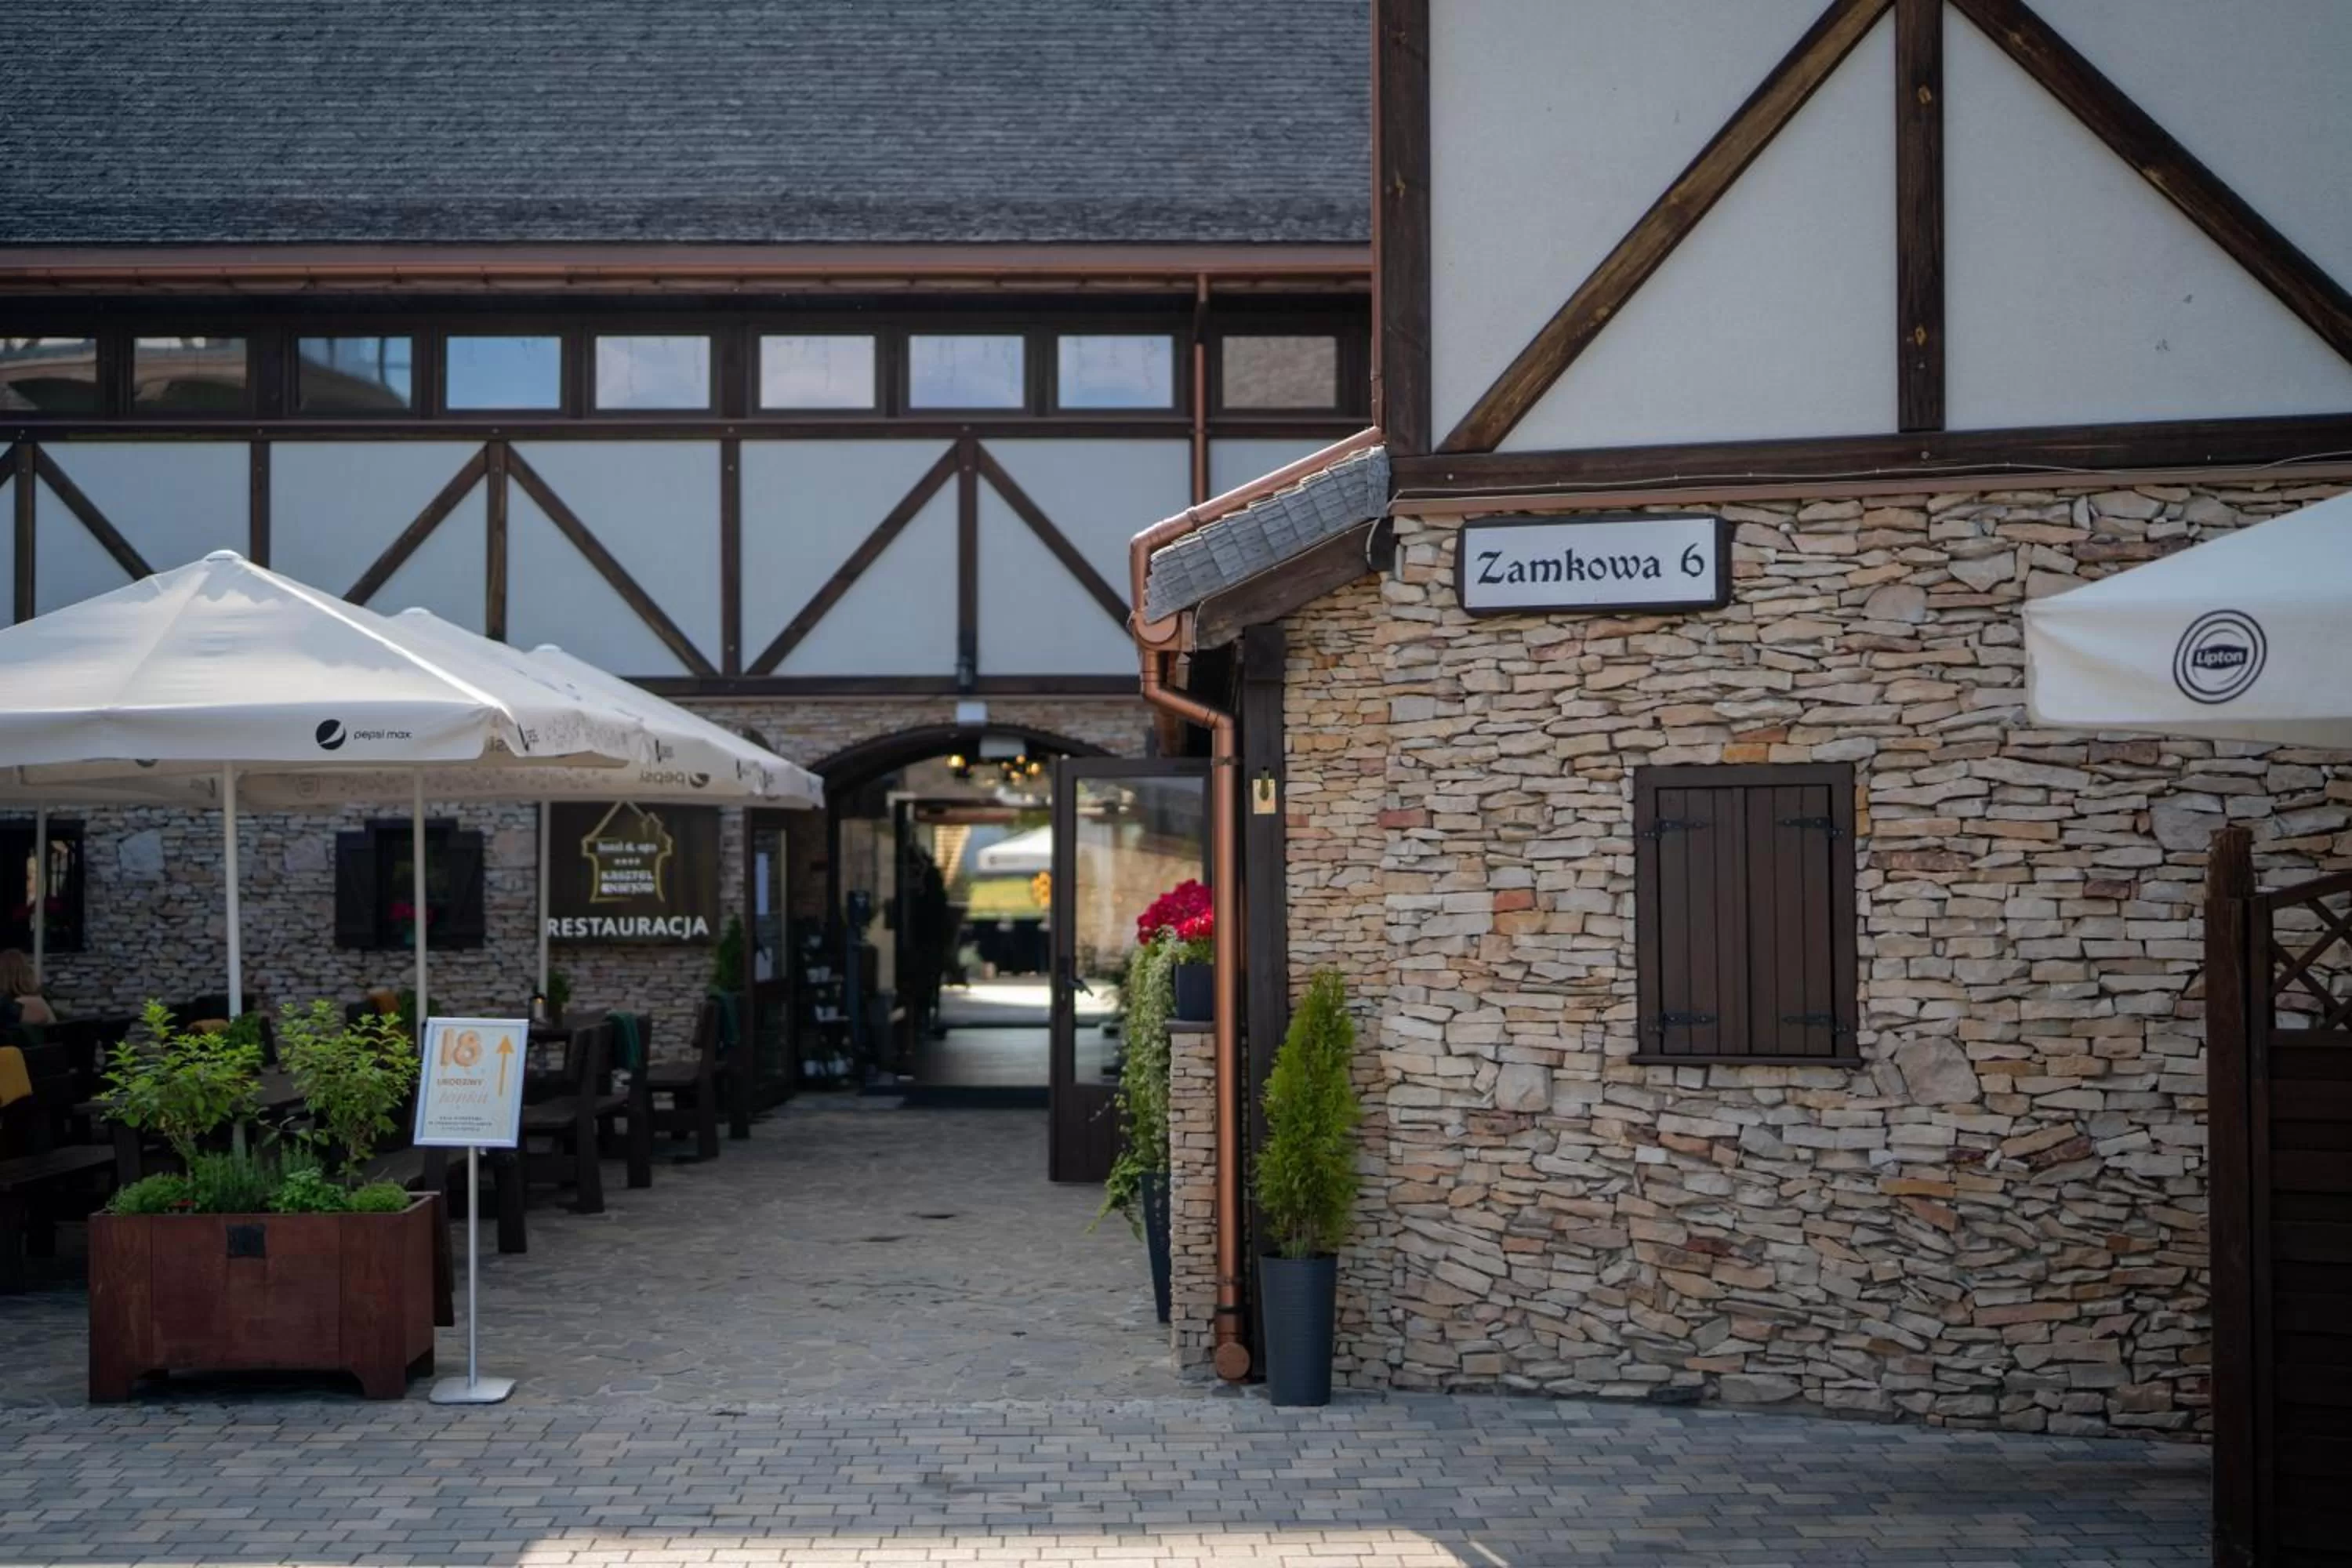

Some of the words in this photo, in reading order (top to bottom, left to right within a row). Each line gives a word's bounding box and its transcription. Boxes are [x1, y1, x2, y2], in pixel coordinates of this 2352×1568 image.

[1477, 548, 1662, 585] Zamkowa
[1680, 542, 1706, 578] 6
[2196, 651, 2244, 666] Lipton
[354, 729, 384, 740] pepsi
[547, 916, 709, 938] RESTAURACJA
[440, 1028, 482, 1067] 18
